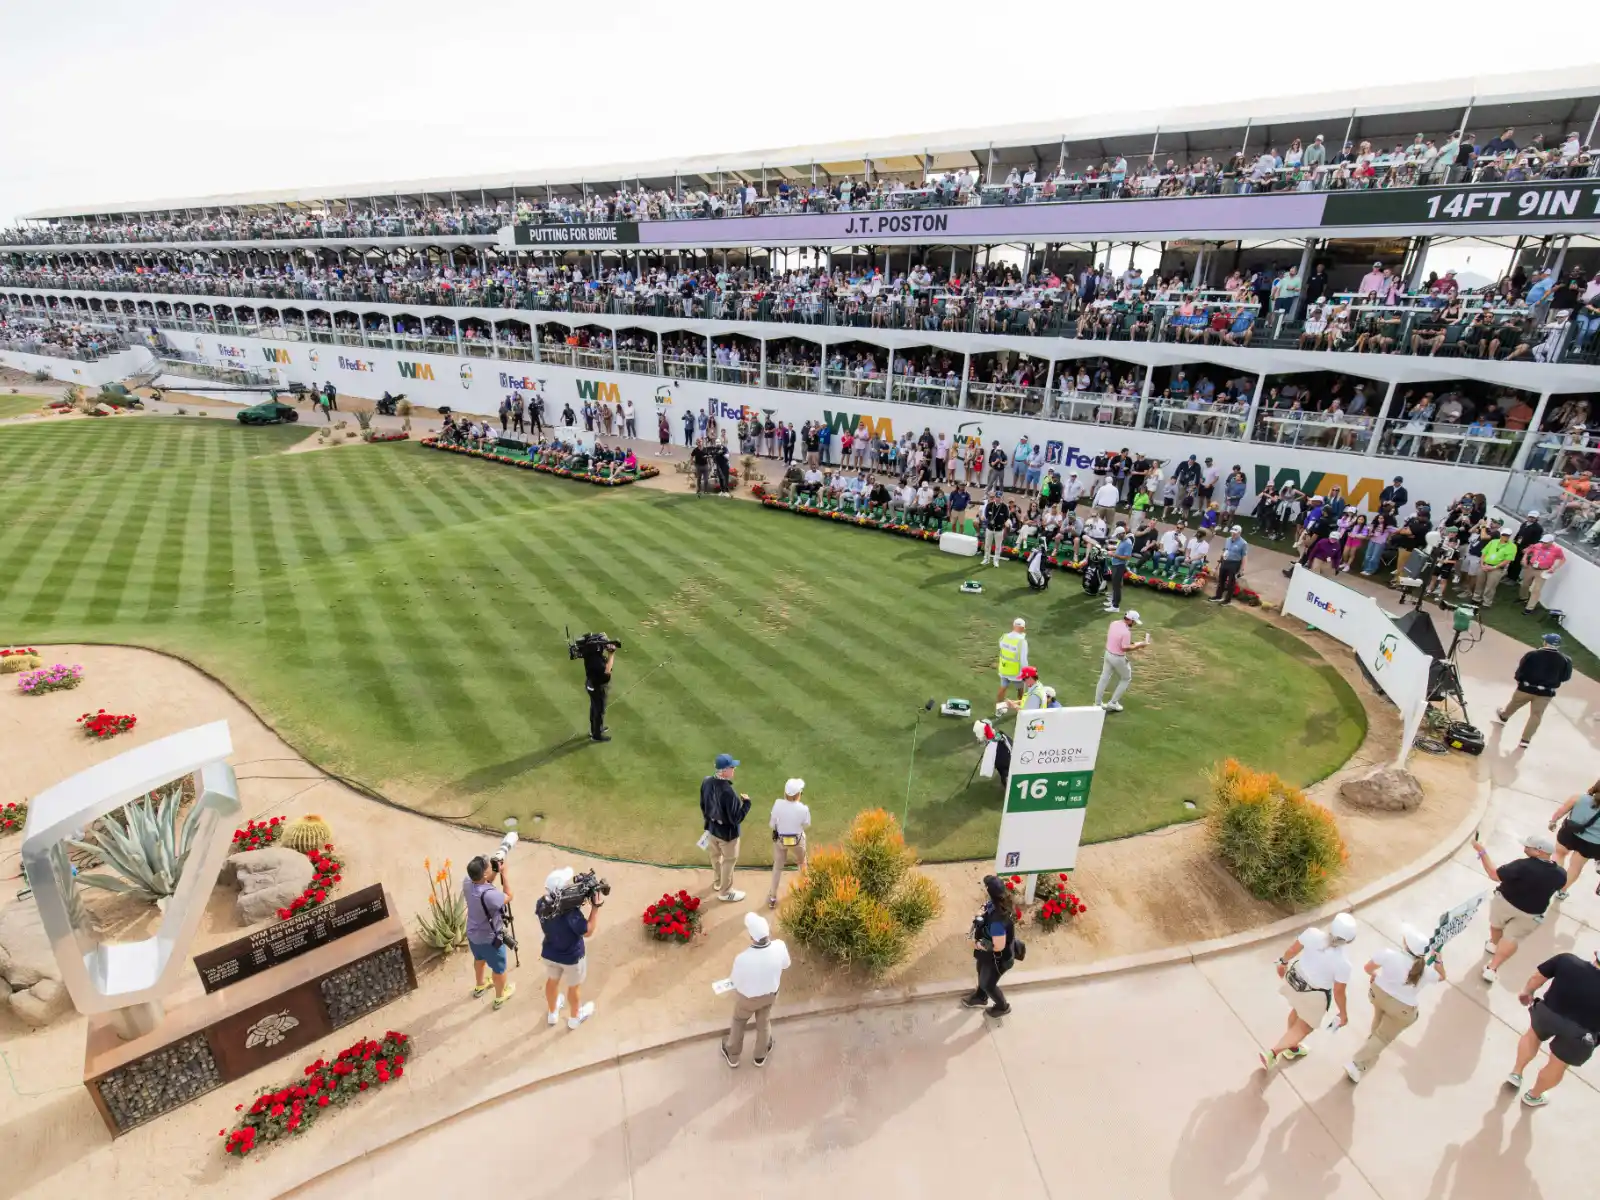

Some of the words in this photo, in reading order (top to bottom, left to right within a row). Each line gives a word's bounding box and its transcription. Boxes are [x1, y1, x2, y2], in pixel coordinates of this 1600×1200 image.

[1427, 191, 1512, 219] 14FT
[1518, 189, 1581, 216] 9IN
[529, 228, 567, 242] PUTTING
[569, 227, 587, 241] FOR
[588, 226, 617, 241] BIRDIE
[845, 216, 873, 234] J.T.
[878, 214, 948, 233] POSTON
[262, 347, 292, 365] WM
[345, 358, 367, 371] FedEx
[397, 360, 435, 381] WM
[508, 376, 536, 391] FedEx
[575, 379, 621, 403] WM
[655, 395, 672, 404] WM
[720, 402, 759, 422] FedEx
[823, 410, 894, 443] WM
[953, 434, 982, 446] WM
[1254, 464, 1384, 513] WM
[1314, 596, 1337, 614] FedEx
[1379, 641, 1393, 663] WM
[1037, 756, 1073, 765] COORS
[1038, 748, 1082, 756] MOLSON
[1016, 778, 1049, 800] 16
[249, 930, 268, 942] WM
[269, 914, 310, 934] PHOENIX
[311, 903, 336, 917] OPEN
[251, 932, 284, 948] HOLES
[285, 927, 295, 935] IN
[296, 918, 316, 930] ONE
